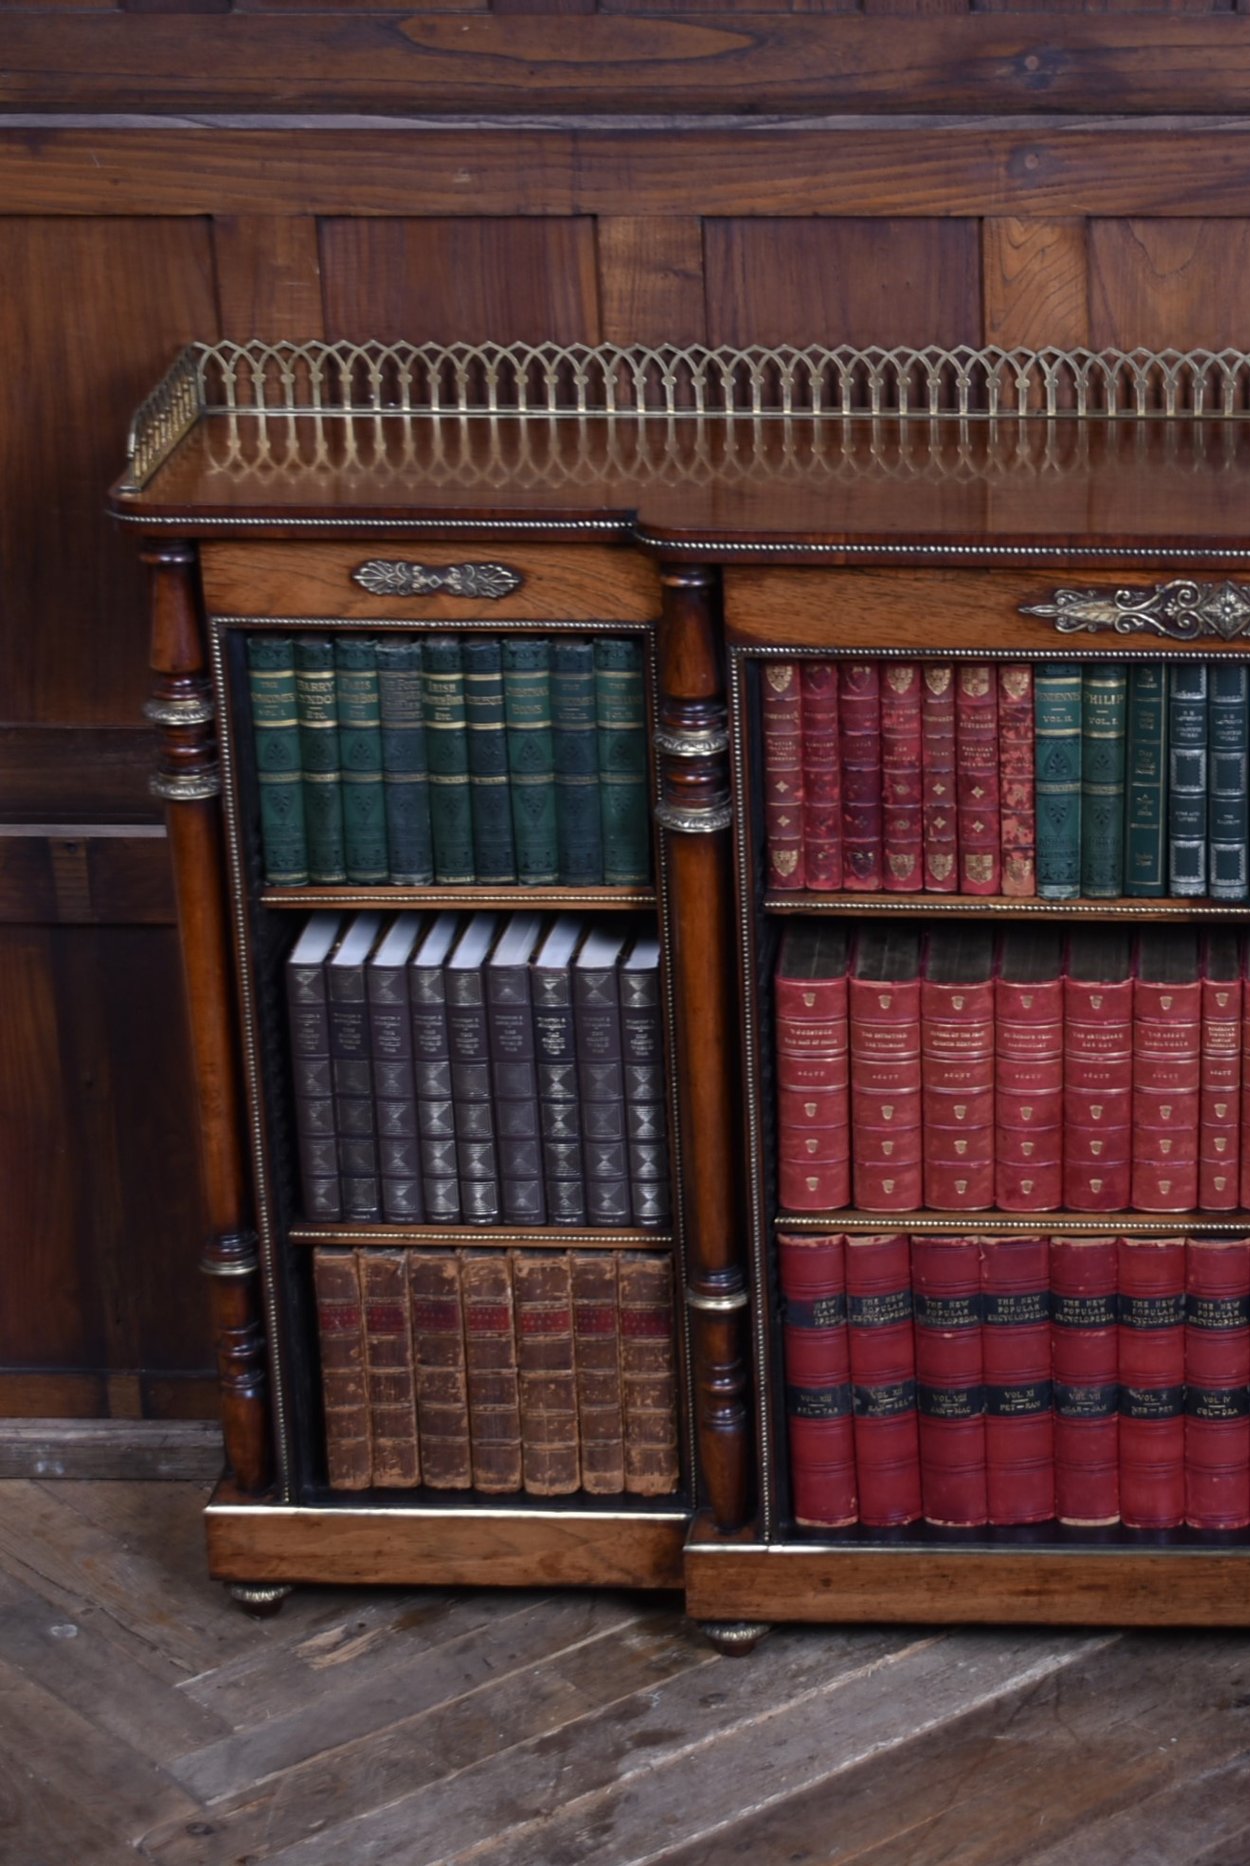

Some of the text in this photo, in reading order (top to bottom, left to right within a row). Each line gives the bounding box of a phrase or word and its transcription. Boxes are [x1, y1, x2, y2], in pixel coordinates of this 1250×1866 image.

[1085, 691, 1124, 705] PHILIP
[863, 1298, 879, 1306] THE
[1063, 1299, 1080, 1307] THE
[1132, 1300, 1148, 1308] THE
[1198, 1302, 1214, 1310] THE
[863, 1301, 904, 1314] POPULAR
[998, 1304, 1040, 1313] POPULAR
[1064, 1307, 1105, 1315] POPULAR
[1132, 1308, 1174, 1316] POPULAR
[1198, 1310, 1240, 1319] POPULAR
